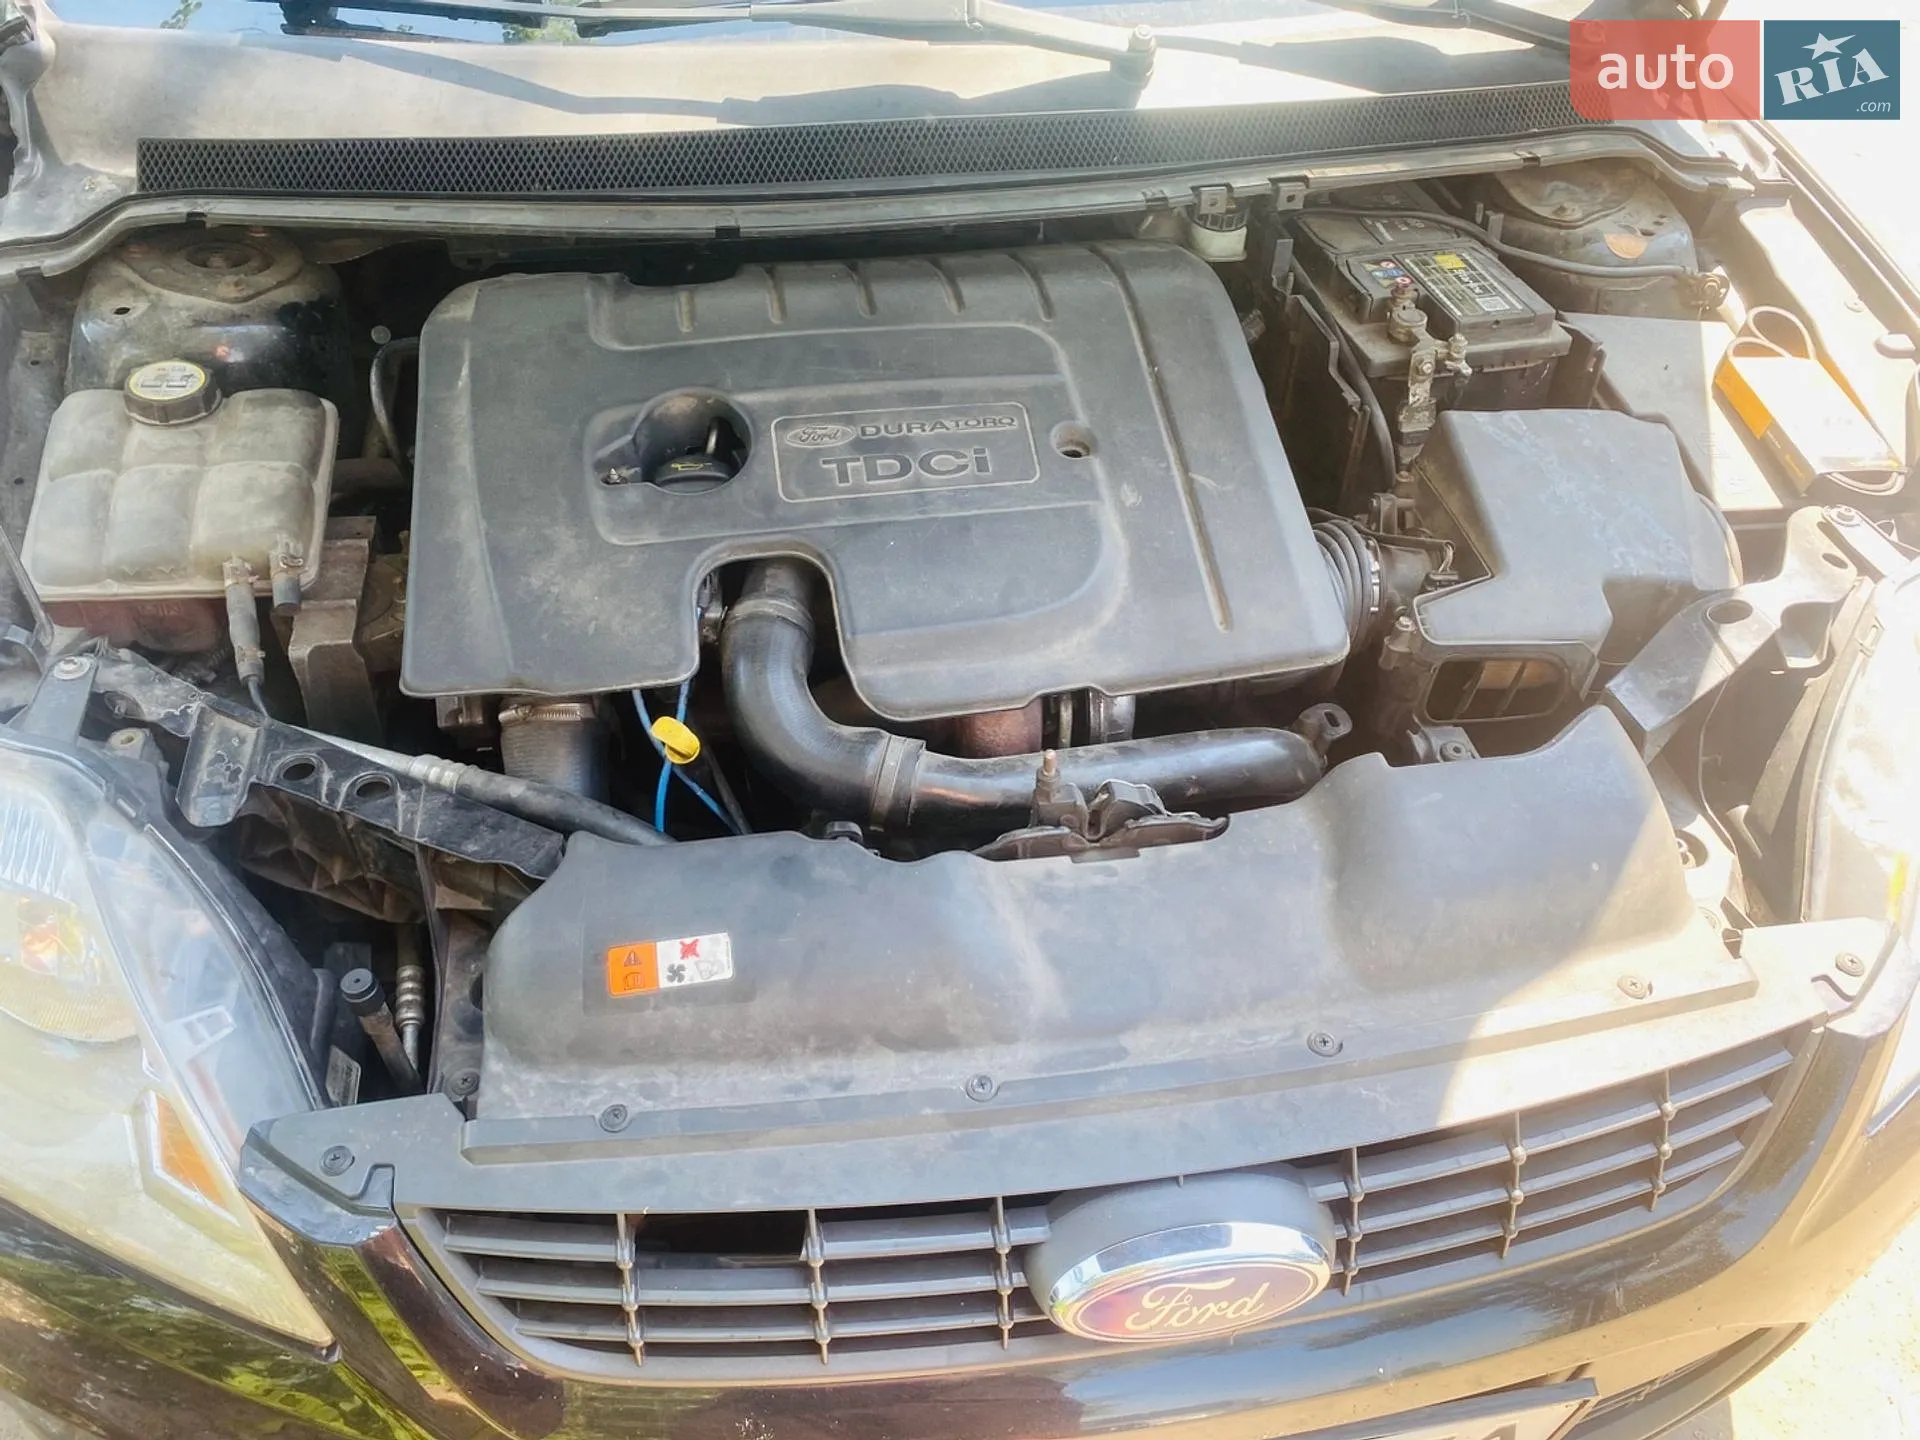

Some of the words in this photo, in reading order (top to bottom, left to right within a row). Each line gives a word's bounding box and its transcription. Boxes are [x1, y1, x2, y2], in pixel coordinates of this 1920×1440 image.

[799, 425, 841, 442] Ford
[859, 415, 1017, 438] DURATORQ
[820, 447, 992, 487] TDCi
[1124, 1277, 1270, 1331] Ford
